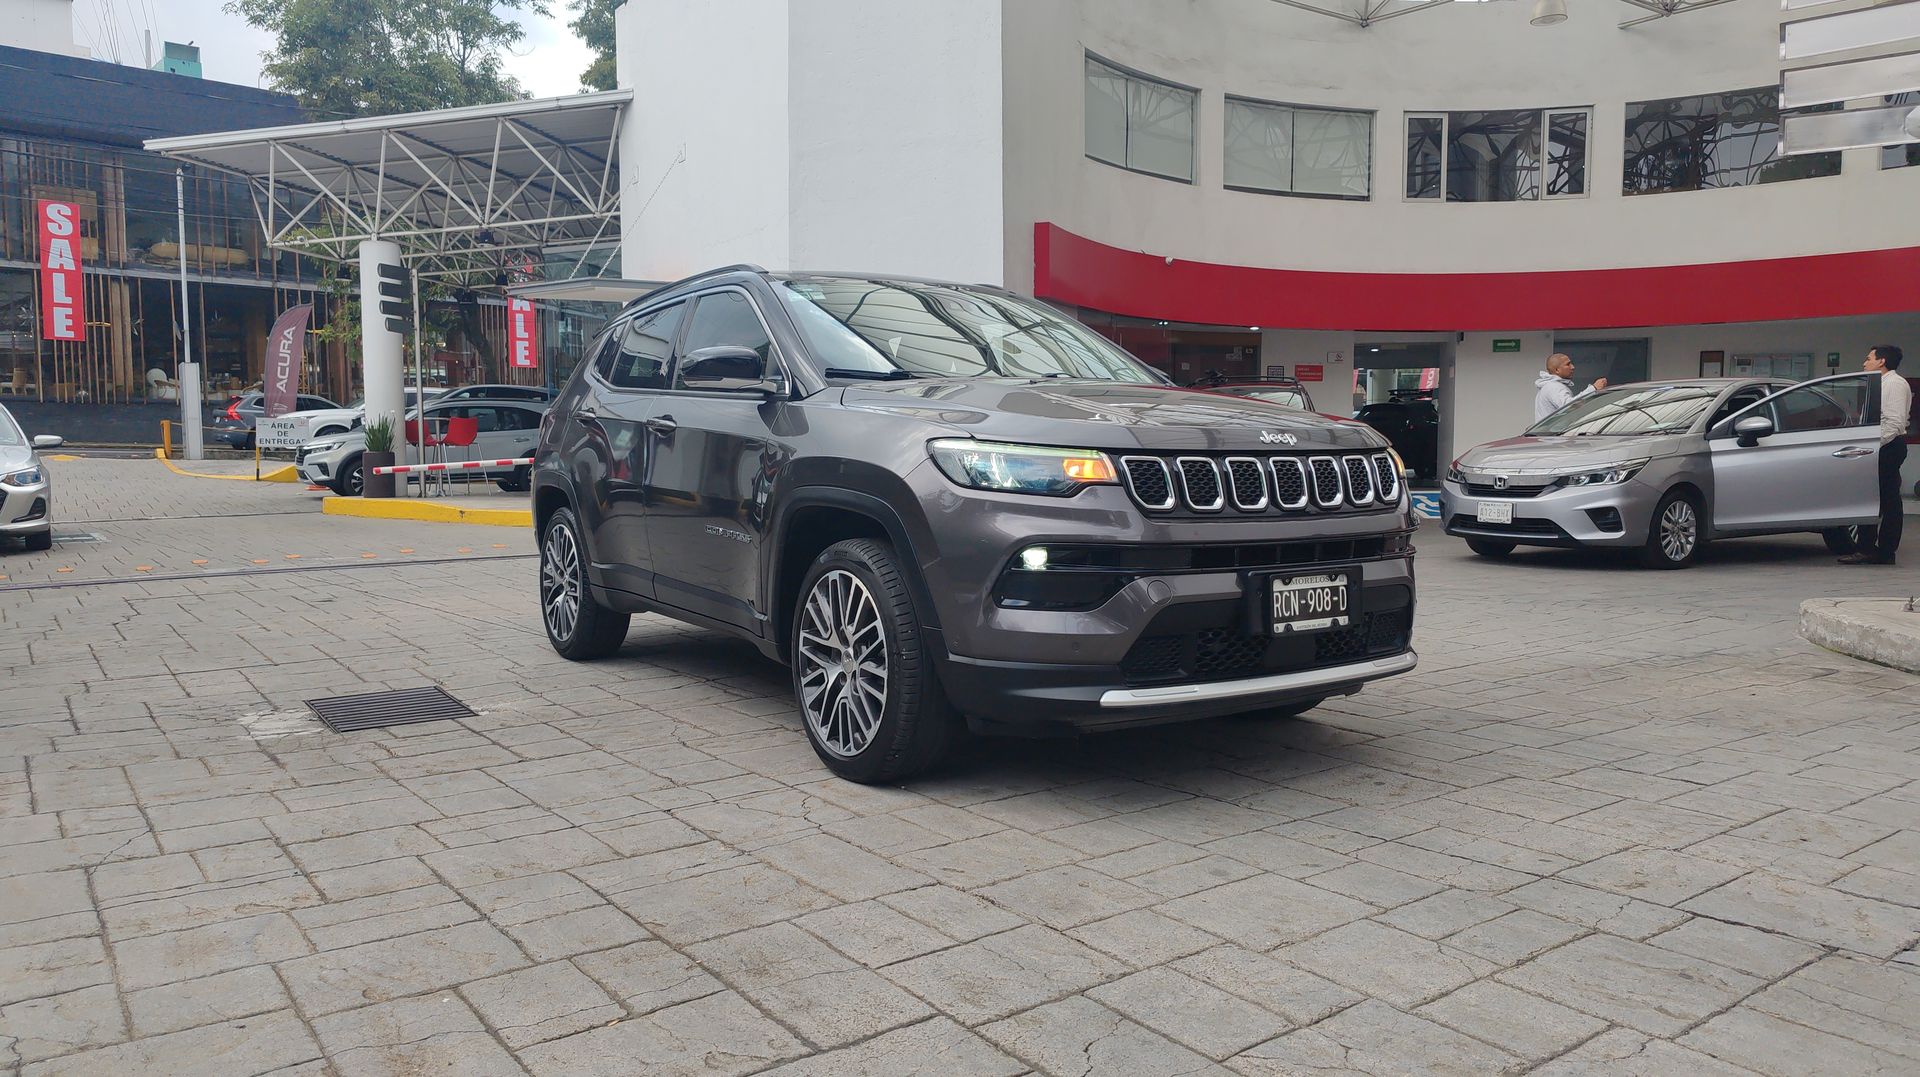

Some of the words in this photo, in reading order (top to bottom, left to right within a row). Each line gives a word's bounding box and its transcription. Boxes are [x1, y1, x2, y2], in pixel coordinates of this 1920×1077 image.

[46, 203, 76, 338] SALE
[276, 326, 296, 393] ACURA
[1259, 430, 1298, 446] Jeep
[1290, 575, 1330, 585] MORELOS
[1273, 585, 1347, 618] RCN-908-D
